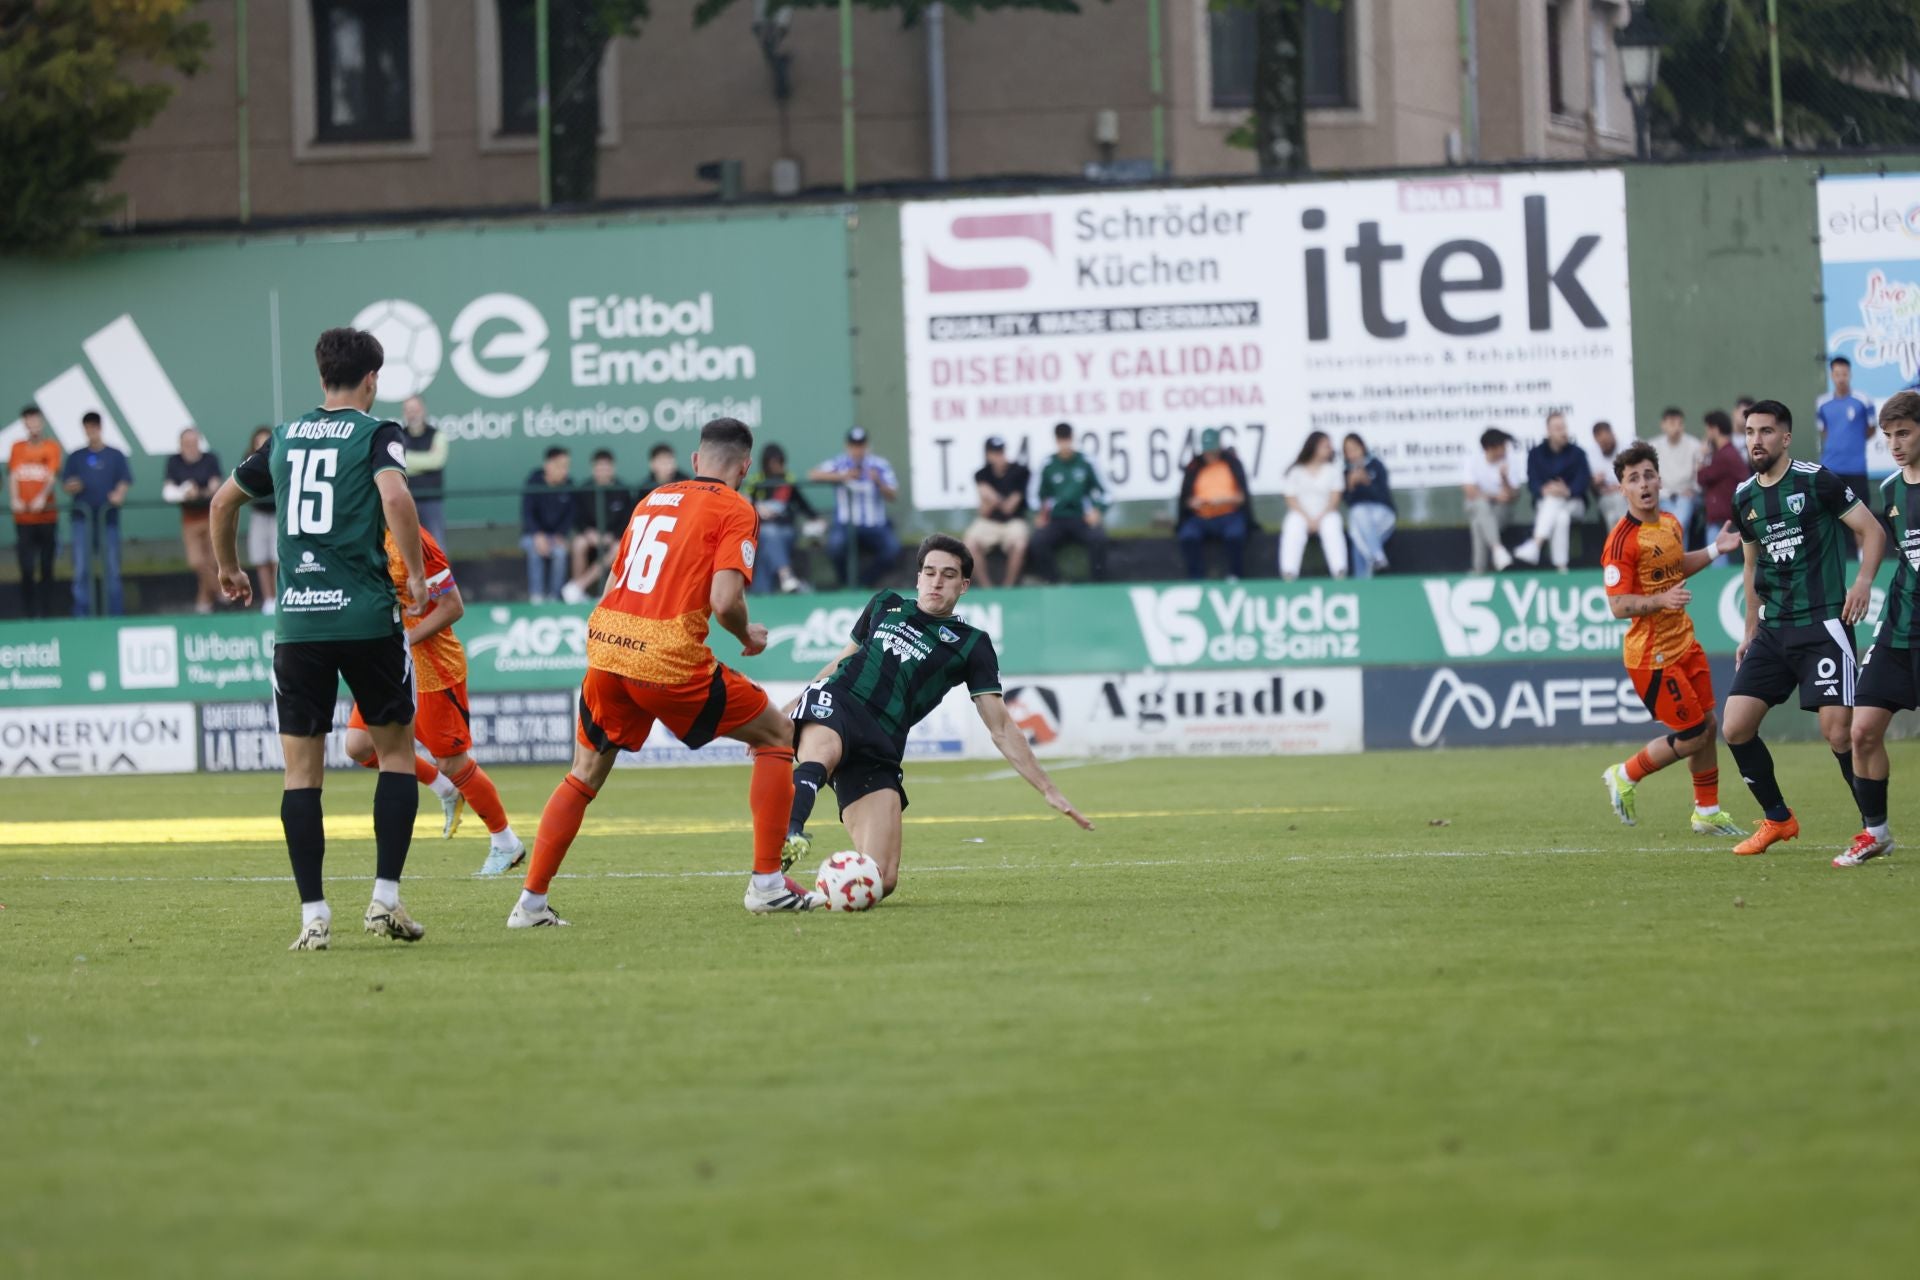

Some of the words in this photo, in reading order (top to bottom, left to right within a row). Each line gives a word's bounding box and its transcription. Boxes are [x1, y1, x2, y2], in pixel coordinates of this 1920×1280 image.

[1075, 203, 1251, 240] Schröder
[1076, 255, 1220, 288] Küchen
[1301, 194, 1609, 340] itek
[569, 292, 713, 340] Fútbol
[570, 340, 756, 387] Emotion
[931, 348, 1061, 386] DISEÑO
[1075, 352, 1095, 379] Y
[1110, 345, 1263, 378] CALIDAD
[523, 402, 649, 438] técnico
[932, 397, 966, 421] EN
[977, 391, 1107, 418] MUEBLES
[1119, 390, 1151, 411] DE
[1163, 385, 1265, 409] COCINA
[286, 448, 338, 535] 15
[615, 514, 678, 594] 16
[281, 586, 343, 605] Andrasa
[1208, 588, 1360, 632] Viuda
[1502, 579, 1617, 624] Viud
[184, 632, 260, 661] Urban
[588, 628, 648, 653] VALCARCE
[873, 630, 926, 661] miramar
[878, 622, 932, 654] AUTONERVION
[1208, 628, 1258, 660] de
[1263, 632, 1360, 660] Sainz
[1502, 622, 1551, 652] de
[1556, 623, 1629, 651] Sain
[817, 691, 833, 706] 6
[1089, 676, 1326, 733] Aguado
[1667, 678, 1682, 701] 9
[0, 752, 138, 775] ACIA
